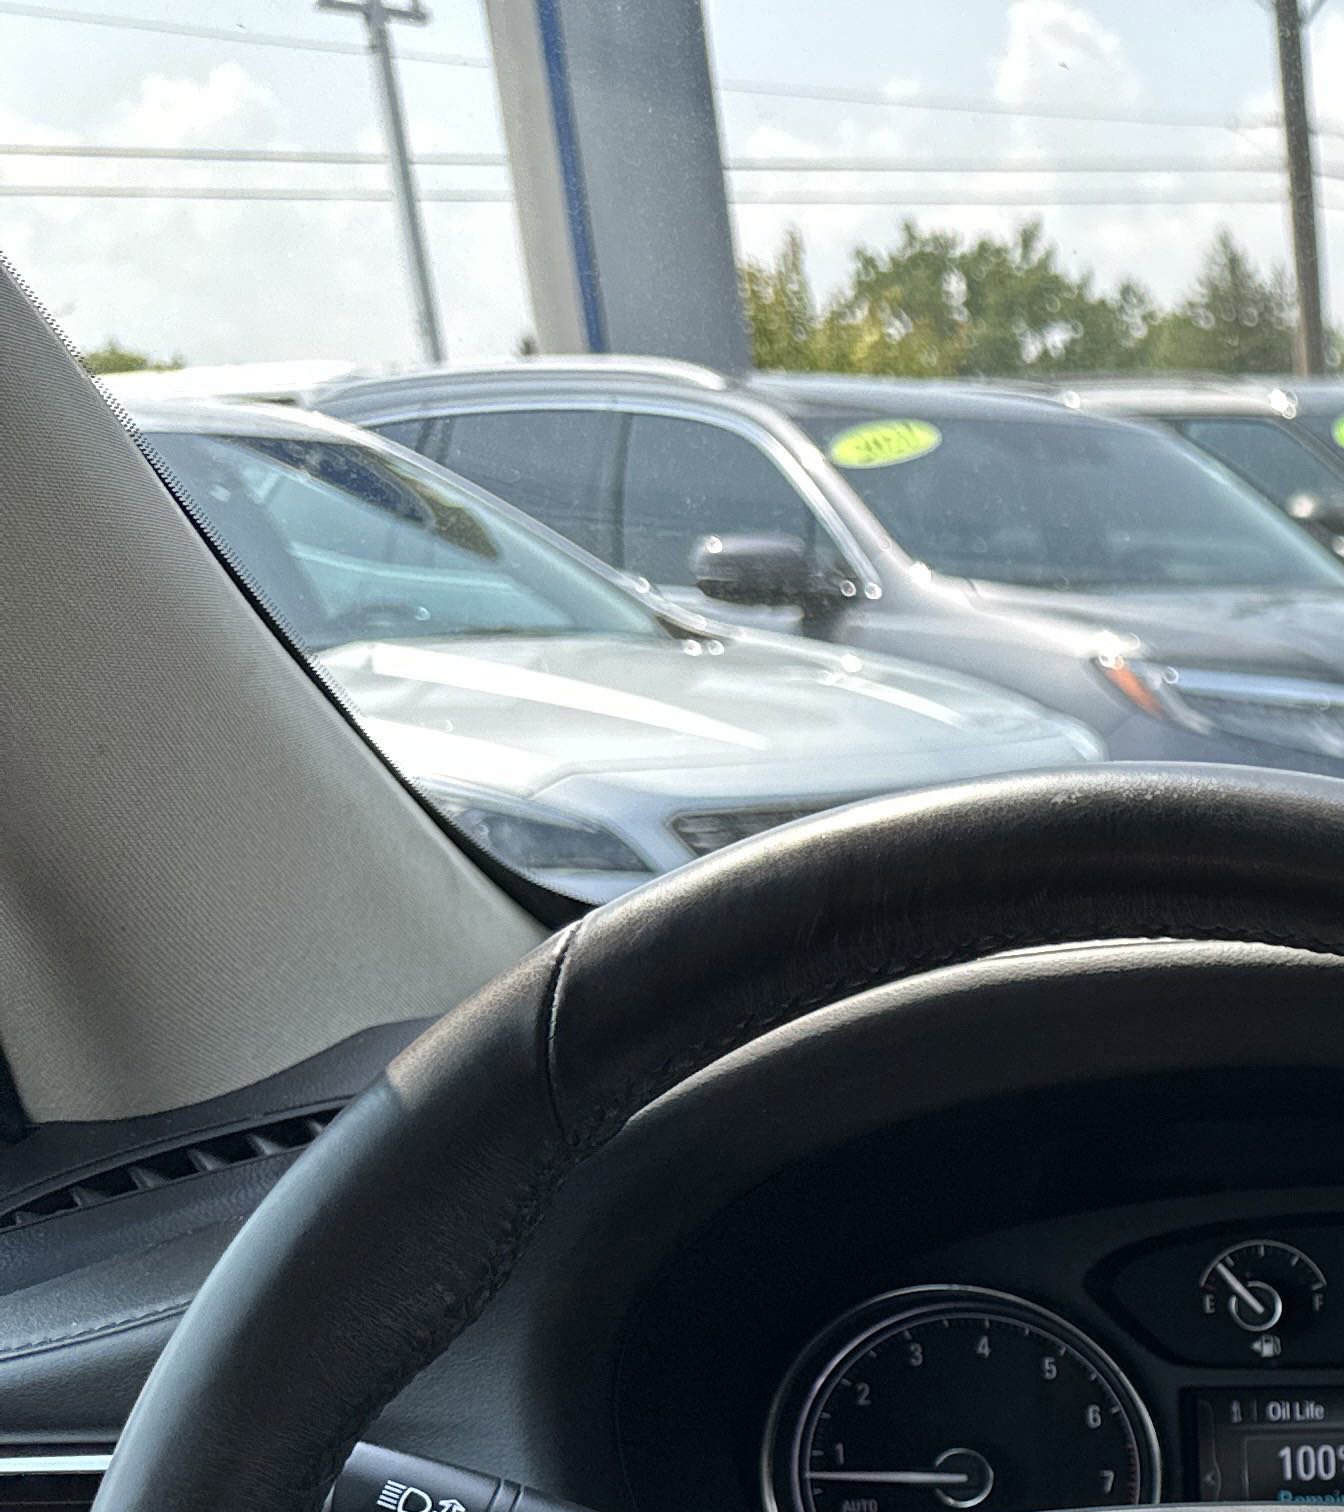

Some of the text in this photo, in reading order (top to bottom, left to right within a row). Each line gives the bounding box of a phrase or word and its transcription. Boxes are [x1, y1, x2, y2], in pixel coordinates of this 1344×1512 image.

[1205, 1296, 1215, 1314] E
[1313, 1295, 1324, 1312] F
[910, 1344, 923, 1367] 3
[977, 1337, 990, 1358] 4
[1042, 1357, 1057, 1379] 5
[857, 1383, 871, 1406] 2
[1087, 1406, 1100, 1428] 6
[1266, 1400, 1325, 1421] Oil Life
[834, 1443, 844, 1463] 1
[1101, 1471, 1114, 1493] 7
[842, 1499, 878, 1512] AUTO
